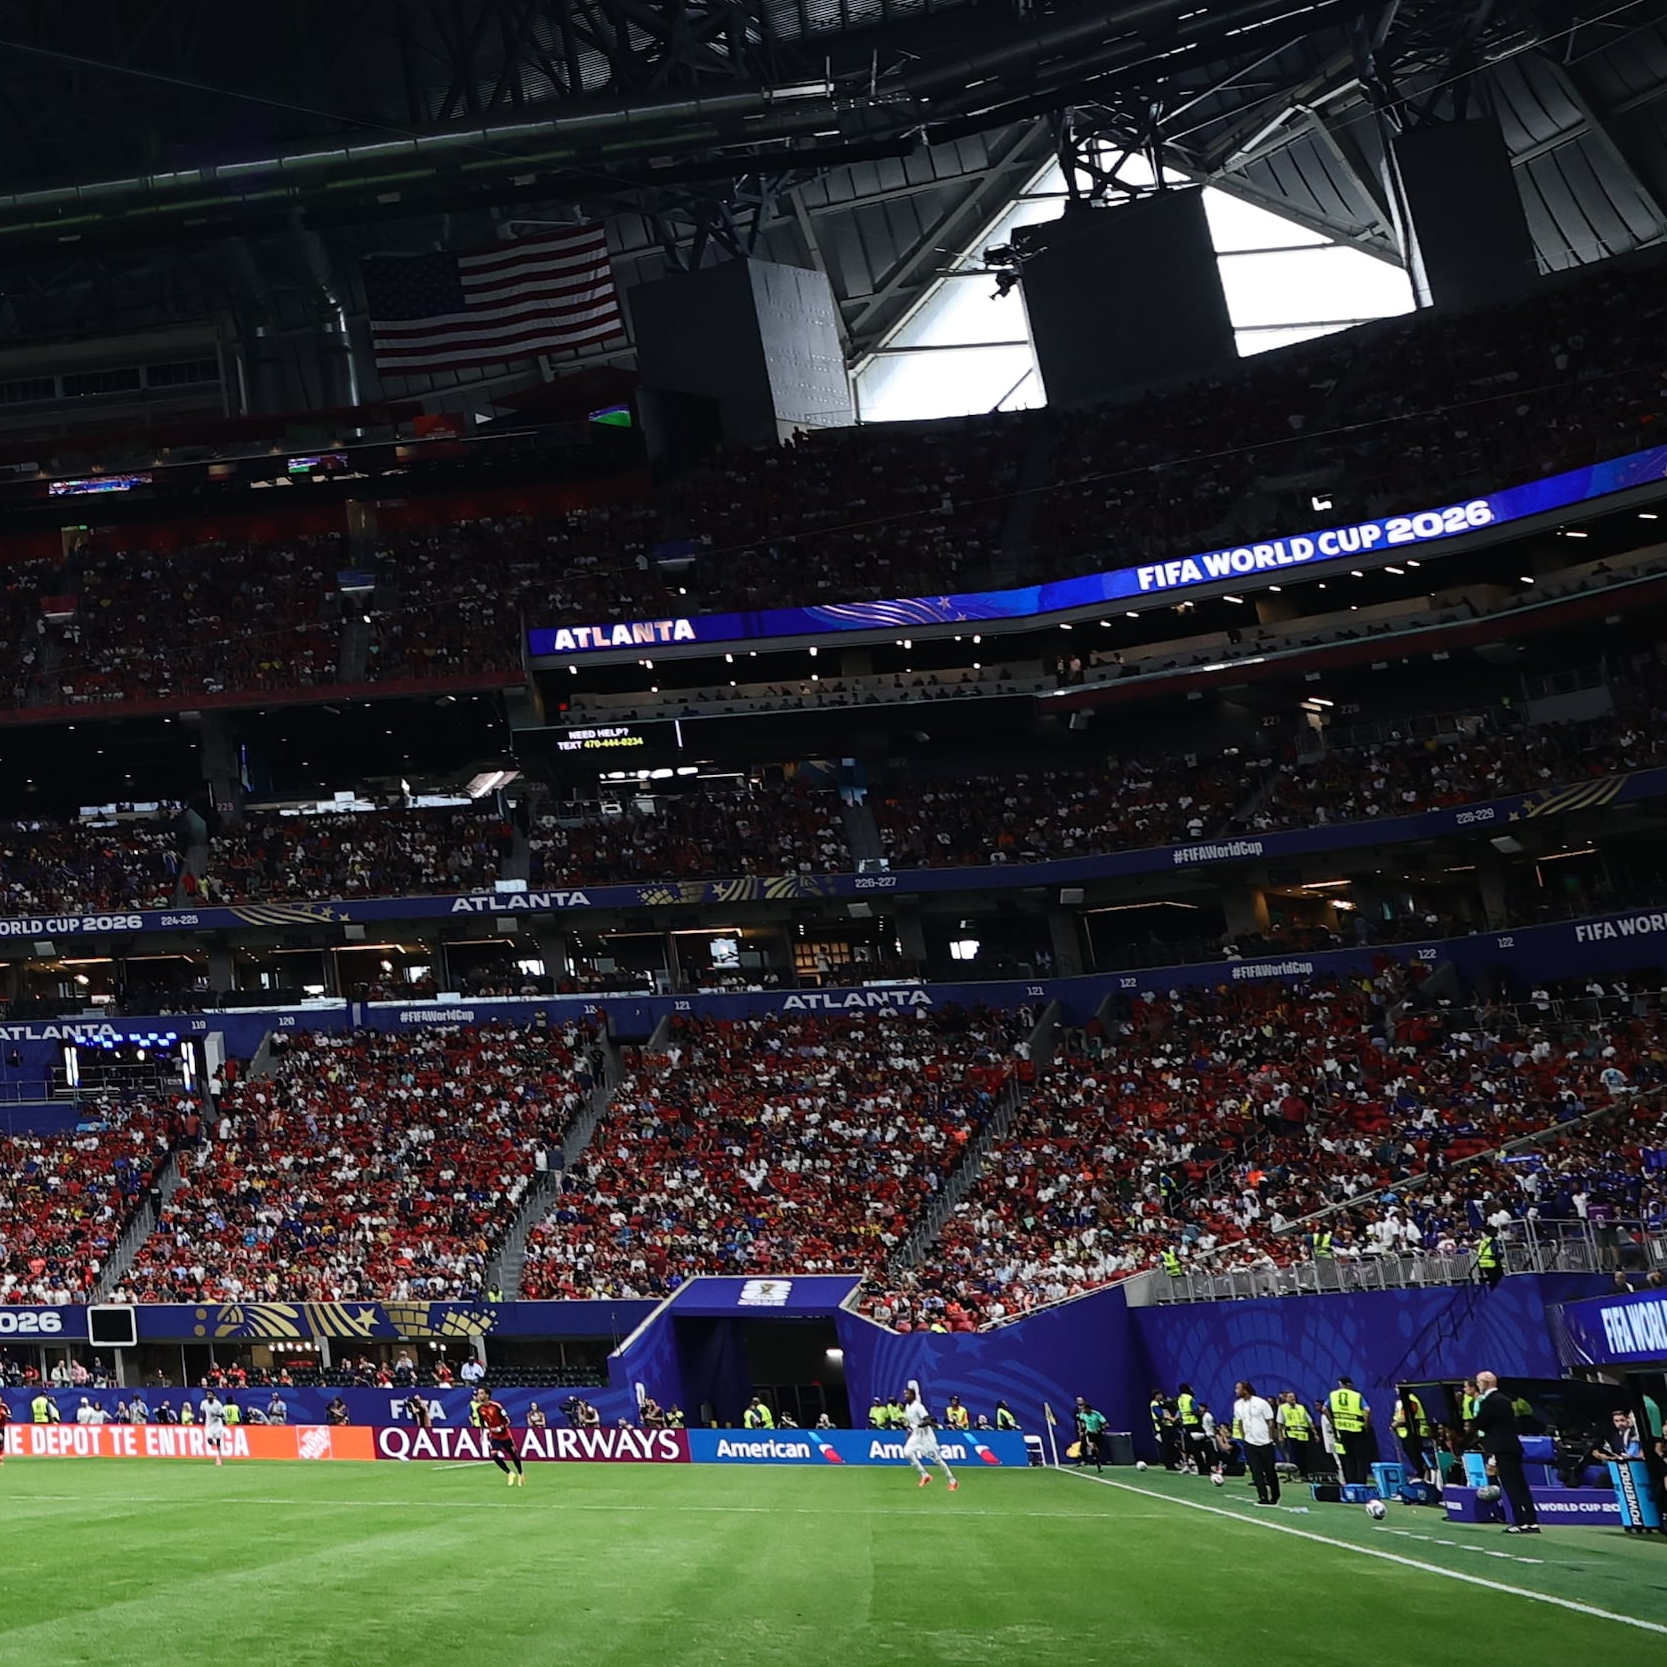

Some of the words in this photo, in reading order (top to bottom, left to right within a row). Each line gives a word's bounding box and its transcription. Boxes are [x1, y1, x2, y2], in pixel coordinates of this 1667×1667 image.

[1136, 560, 1204, 591] FIFA
[1201, 537, 1314, 578] WORLD
[1318, 524, 1381, 559] CUP
[1384, 500, 1493, 545] 2026
[553, 619, 696, 650] ATLANTA
[1173, 841, 1264, 864] #FIFAWorldCup
[451, 891, 592, 912] ATLANTA
[45, 917, 80, 932] CUP
[82, 914, 143, 931] 2026
[1575, 922, 1618, 942] FIFA
[1497, 937, 1514, 948] 122
[1417, 948, 1437, 959] 122
[1231, 962, 1313, 979] #FIFAWorldCup
[1027, 986, 1044, 996] 121
[1119, 978, 1137, 988] 122
[674, 1000, 691, 1011] 121
[783, 990, 933, 1011] ATLANTA
[400, 1009, 475, 1023] #FIFAWorldCup
[1600, 1306, 1635, 1354] FIFA
[31, 1425, 102, 1454] DEPOT
[104, 1425, 137, 1455] TE
[521, 1428, 680, 1462] AIRWAYS
[717, 1437, 810, 1459] American
[1538, 1502, 1578, 1512] WORLD
[1579, 1502, 1602, 1512] CUP
